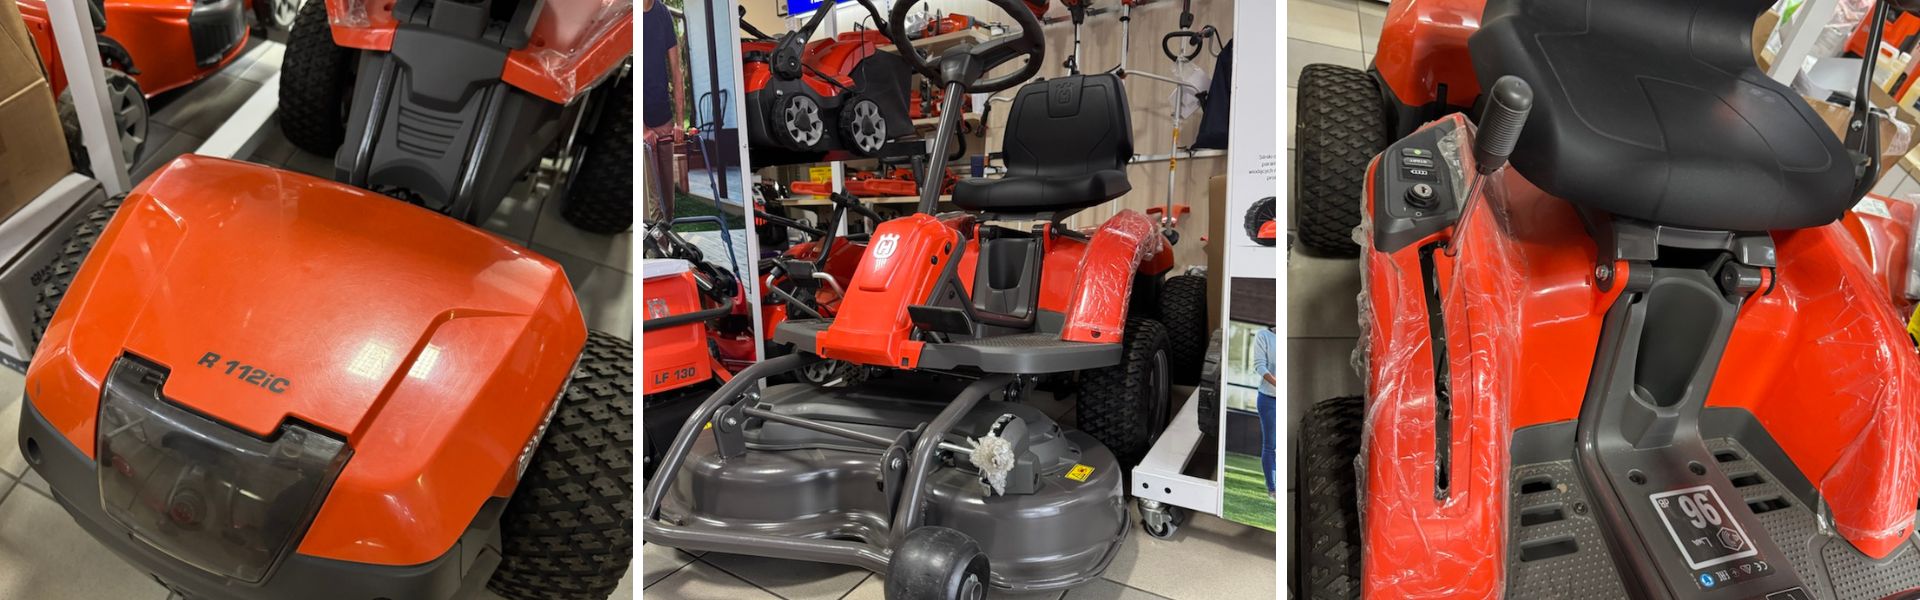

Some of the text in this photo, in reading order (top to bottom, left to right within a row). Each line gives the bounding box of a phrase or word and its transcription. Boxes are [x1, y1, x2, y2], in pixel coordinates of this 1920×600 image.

[197, 351, 290, 393] R 112iC
[655, 367, 696, 385] LF 130
[1657, 498, 1669, 508] dB
[1678, 492, 1722, 529] 96
